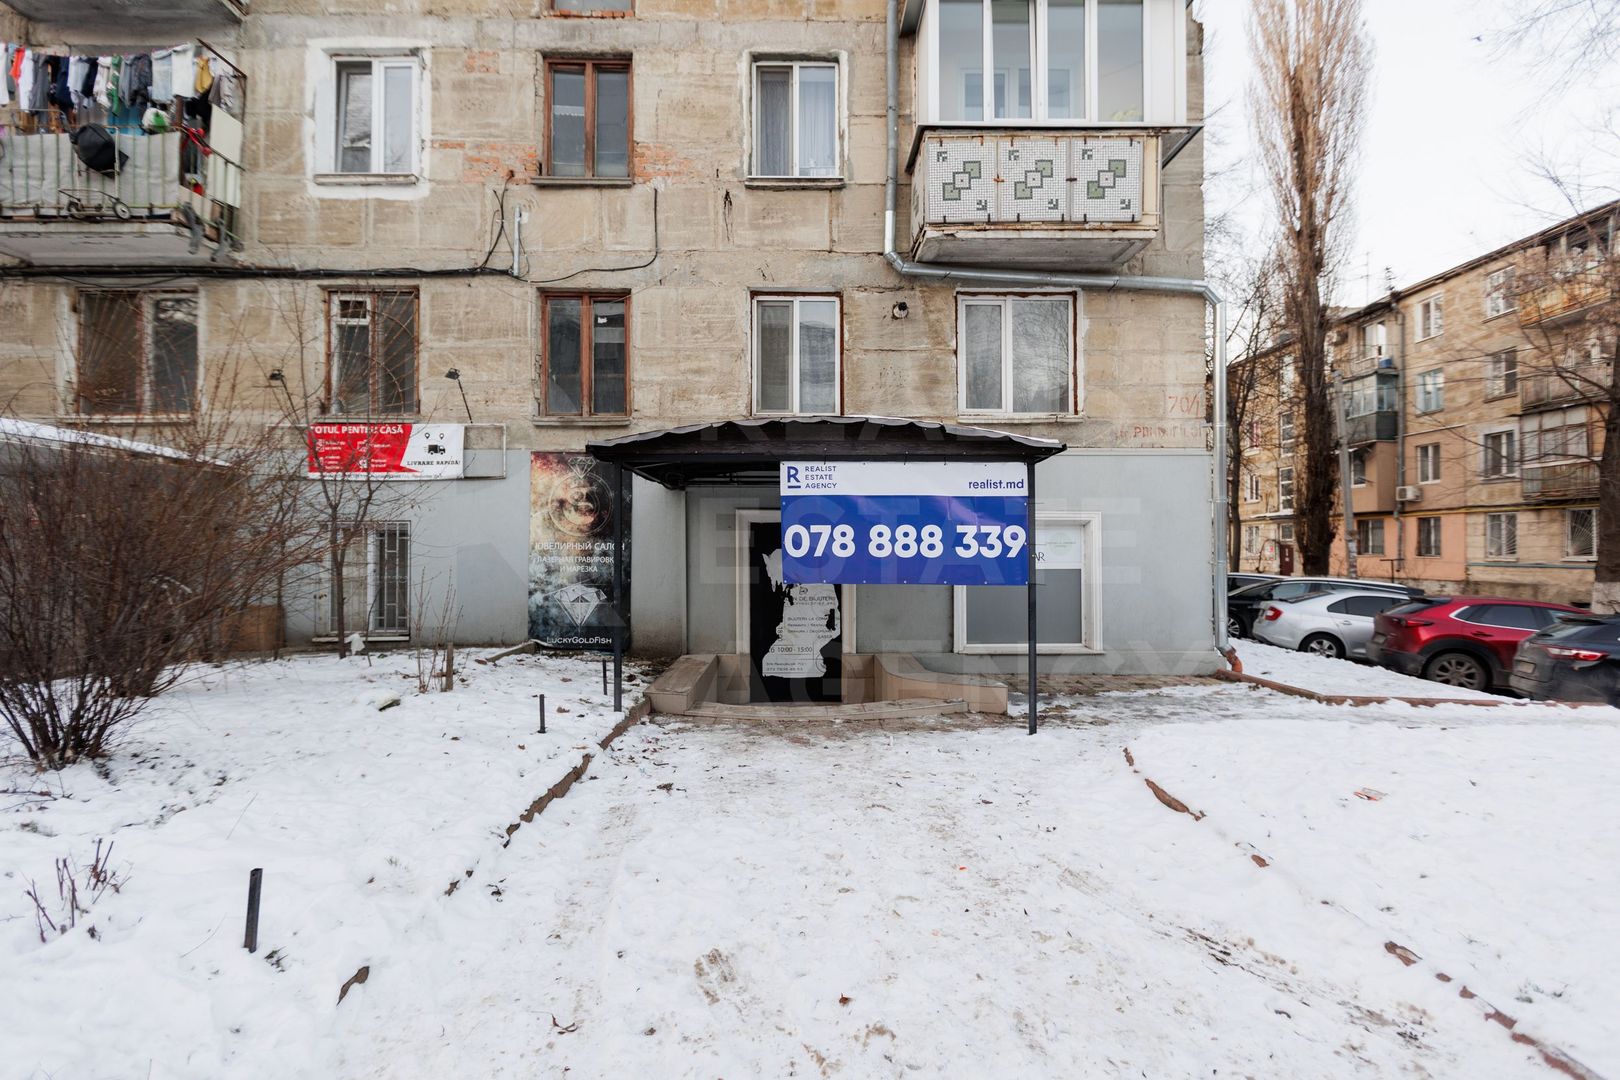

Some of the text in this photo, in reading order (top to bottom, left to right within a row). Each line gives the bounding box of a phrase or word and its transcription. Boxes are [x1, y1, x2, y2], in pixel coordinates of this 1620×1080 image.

[379, 424, 404, 434] CASĂ
[968, 478, 1024, 489] realist.md
[535, 541, 592, 550] ЮВЕЛИРНЫЙ
[784, 524, 1027, 559] 078 888 339
[575, 556, 614, 564] ГРАВИРОВК
[567, 565, 598, 573] НАРЕЗКА
